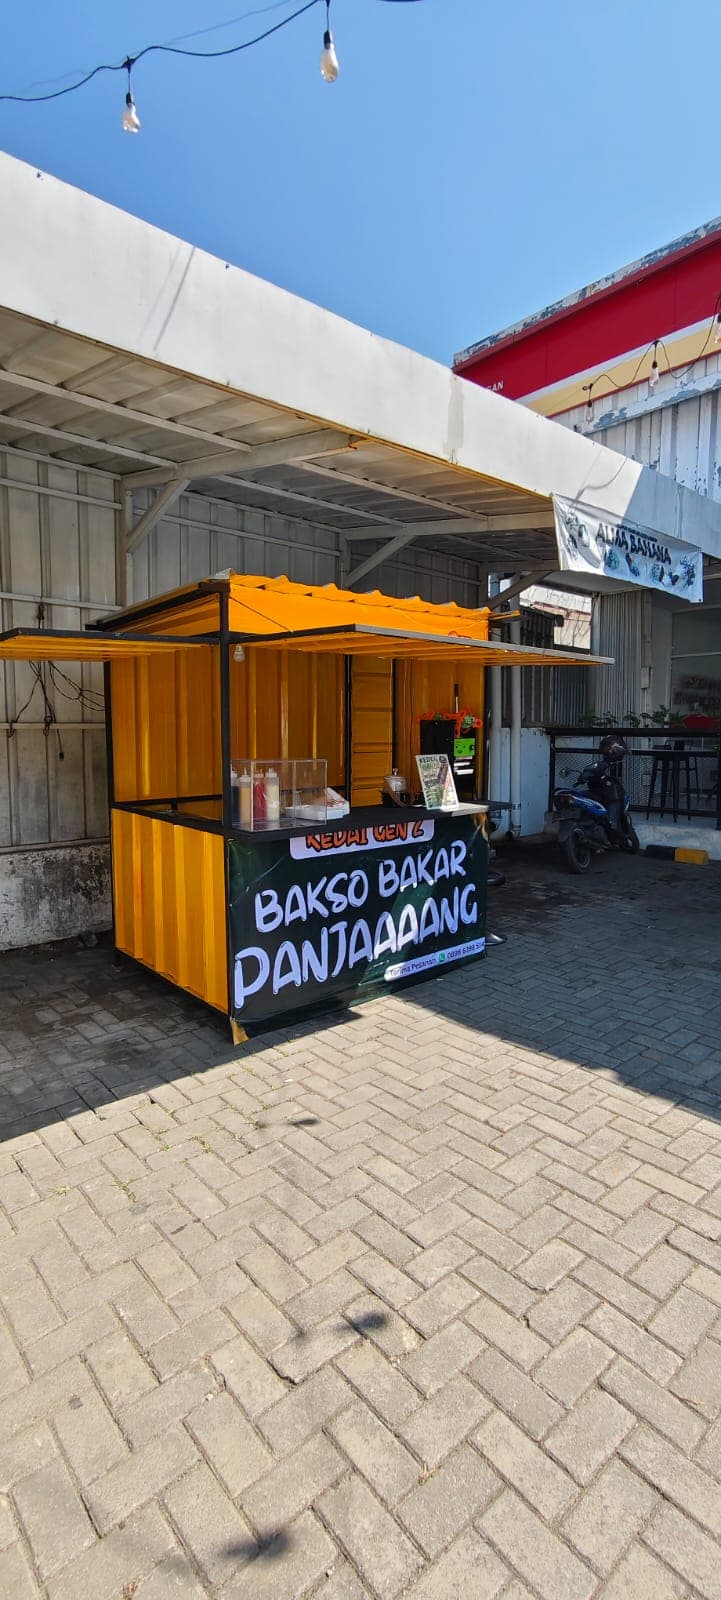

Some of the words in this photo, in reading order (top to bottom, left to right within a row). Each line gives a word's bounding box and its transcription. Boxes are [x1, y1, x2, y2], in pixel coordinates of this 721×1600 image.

[373, 821, 408, 842] GEN
[255, 870, 369, 933] BAKSO
[378, 840, 467, 897] BAKAR
[233, 883, 478, 1009] PANJAAAANG
